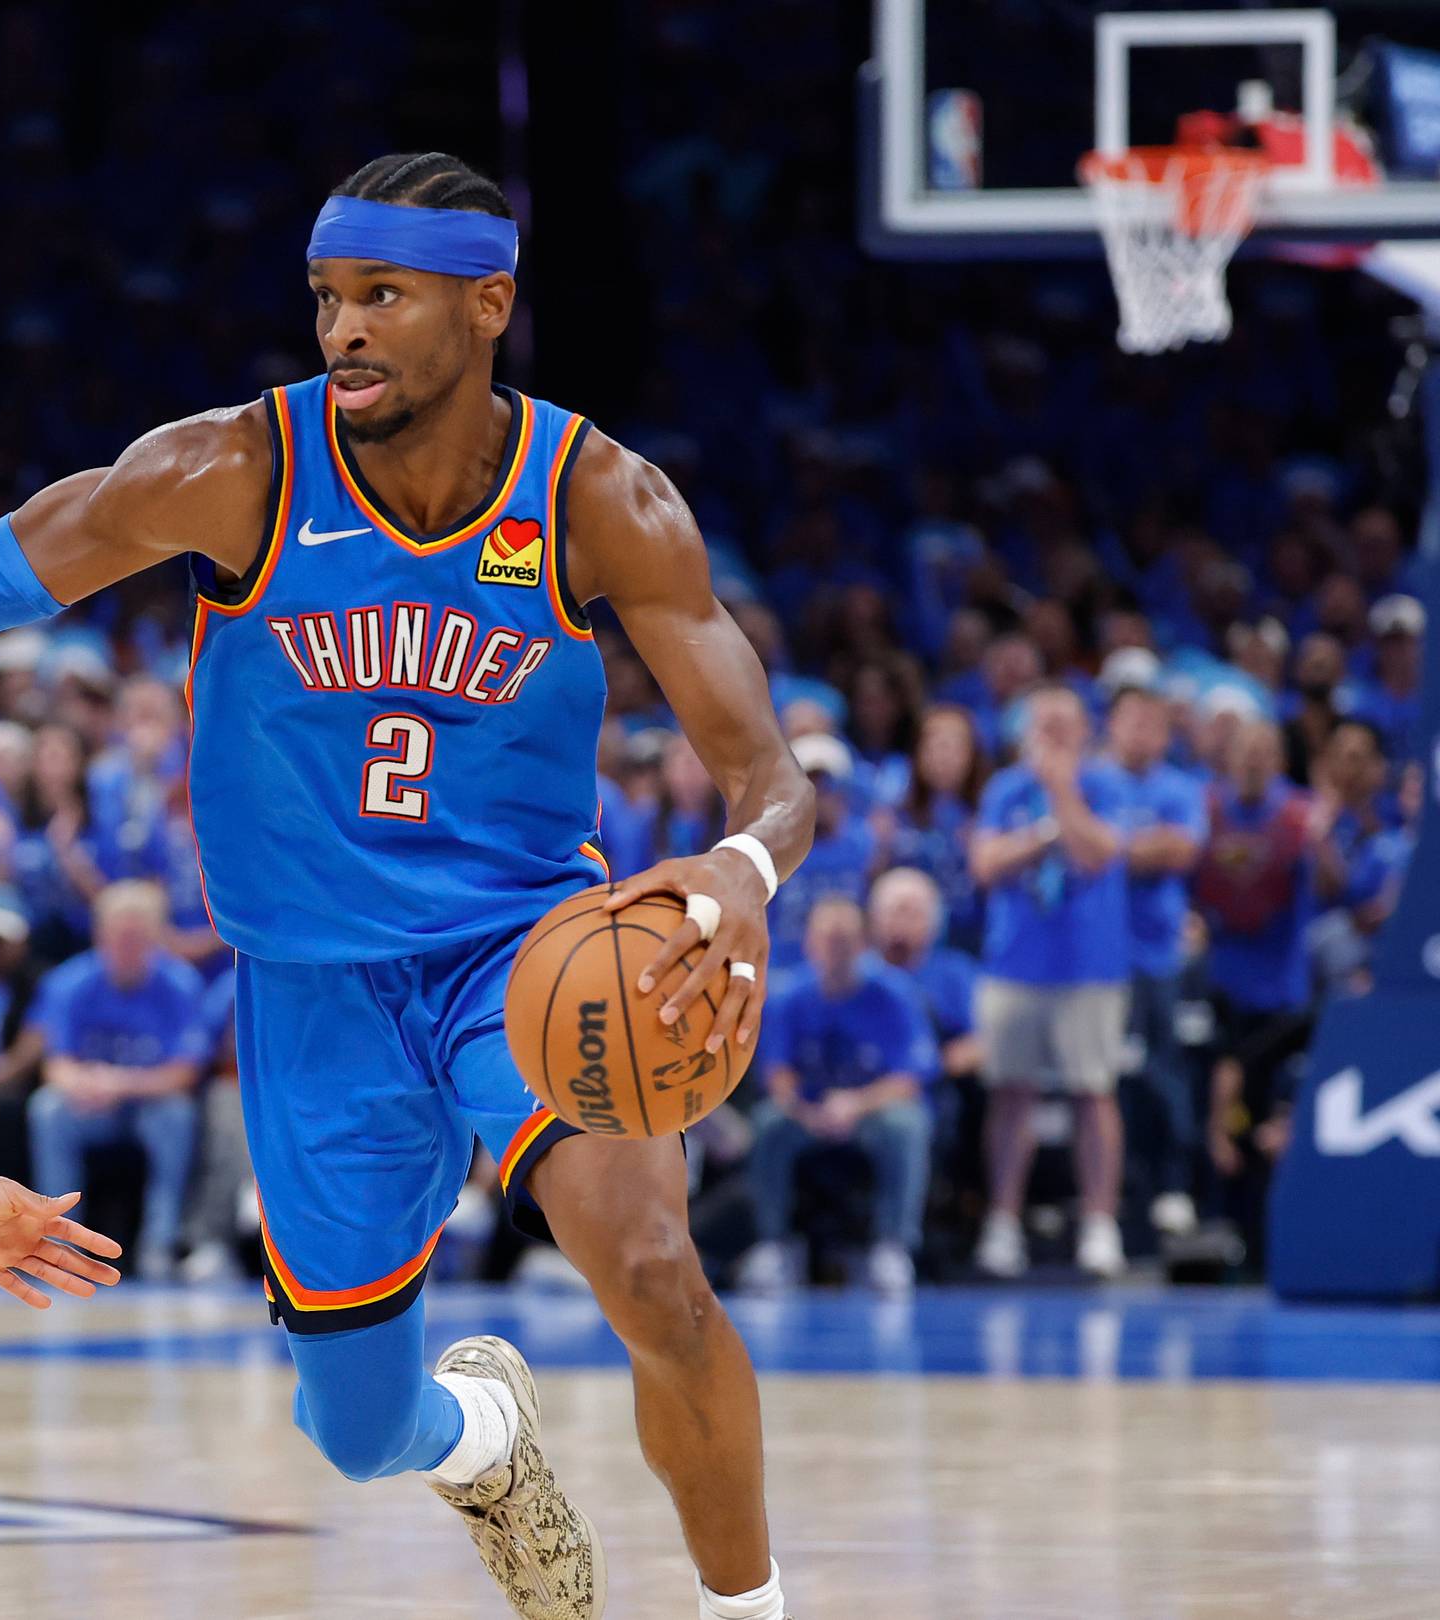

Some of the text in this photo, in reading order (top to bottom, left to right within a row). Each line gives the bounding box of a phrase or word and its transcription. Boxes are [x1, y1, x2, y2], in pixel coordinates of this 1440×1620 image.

[267, 601, 553, 704] THUNDER
[361, 711, 434, 824] 2
[569, 999, 628, 1136] Wilson
